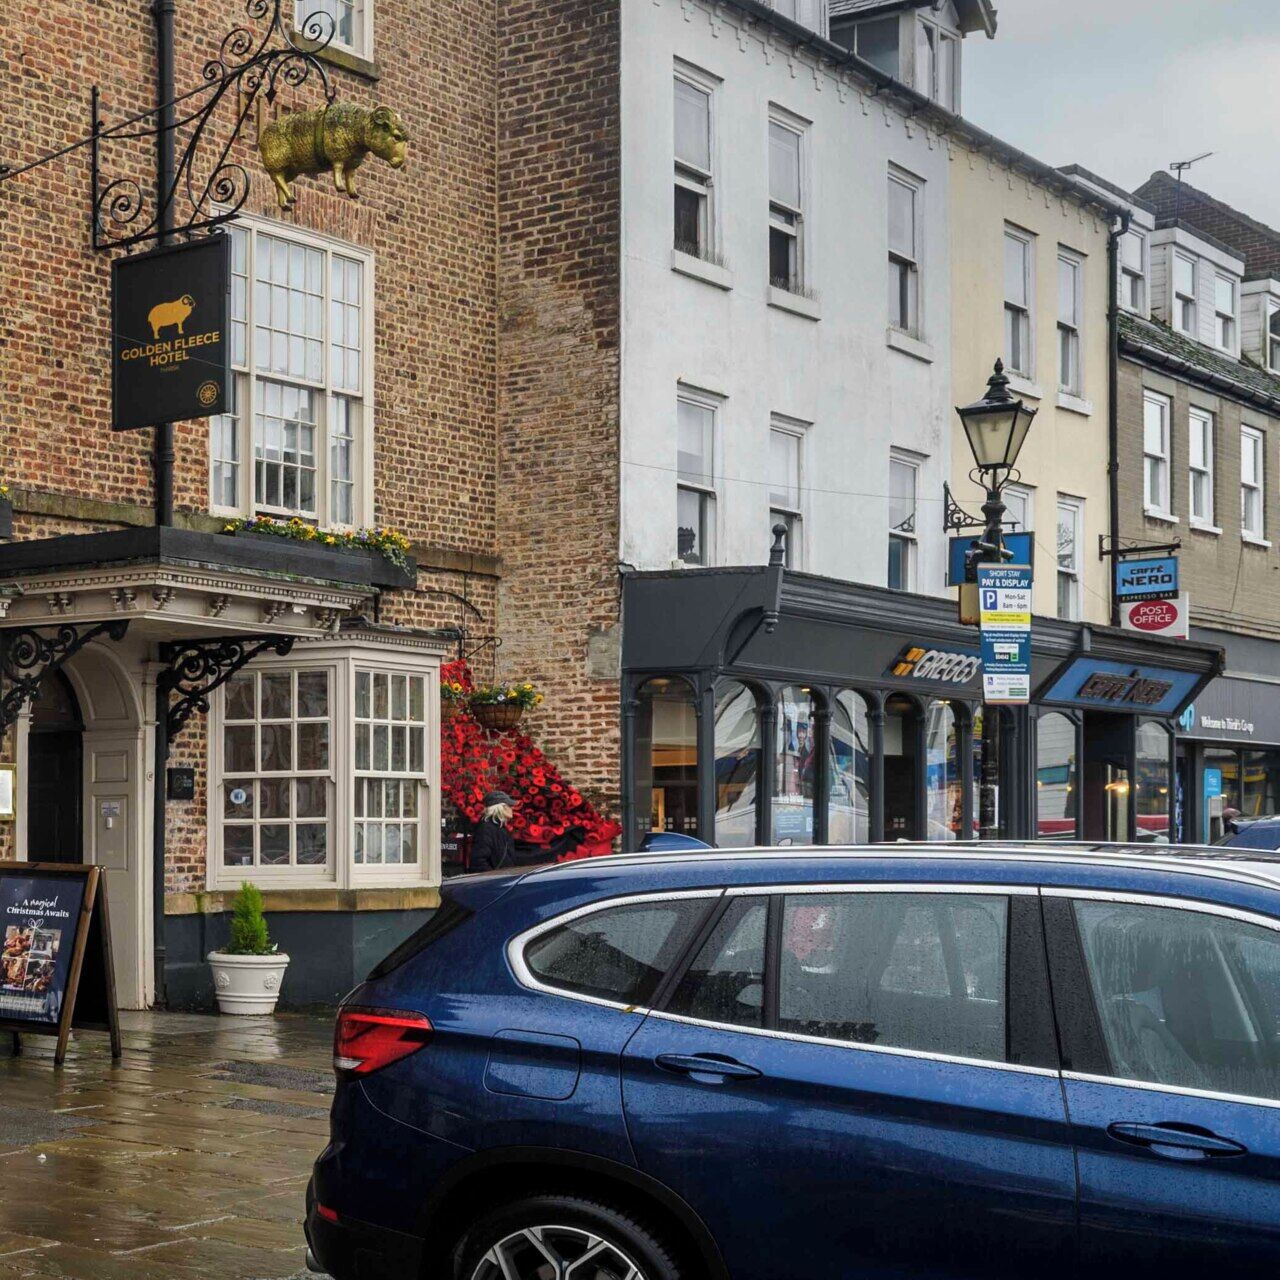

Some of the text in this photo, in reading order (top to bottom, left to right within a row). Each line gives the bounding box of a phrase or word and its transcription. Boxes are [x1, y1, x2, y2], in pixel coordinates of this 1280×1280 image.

[121, 331, 219, 360] GOLDEN FLEECE
[150, 351, 189, 366] HOTEL
[1122, 574, 1172, 586] NERO
[987, 592, 995, 607] P
[1140, 606, 1168, 615] POST
[1134, 614, 1172, 624] OFFICE
[913, 650, 982, 683] GREGGS
[30, 896, 58, 910] magical
[7, 907, 43, 915] Christmas
